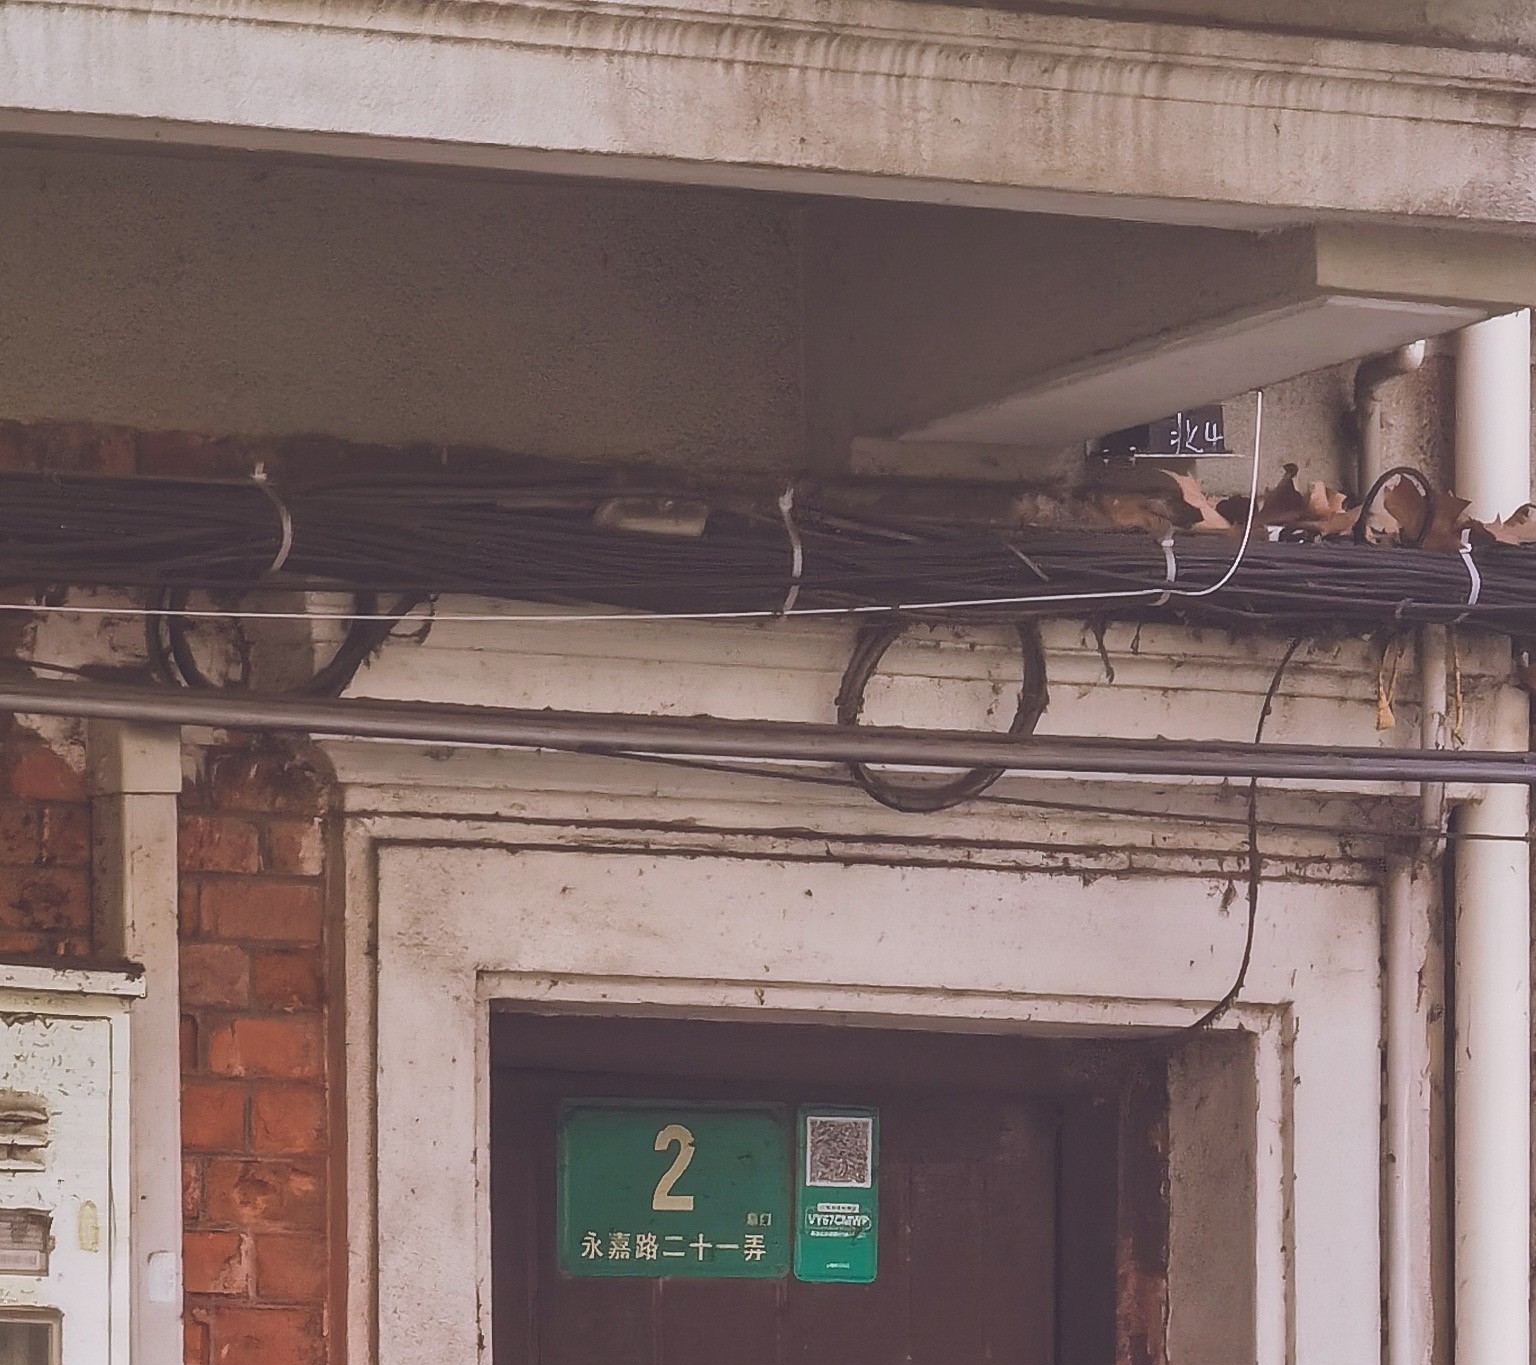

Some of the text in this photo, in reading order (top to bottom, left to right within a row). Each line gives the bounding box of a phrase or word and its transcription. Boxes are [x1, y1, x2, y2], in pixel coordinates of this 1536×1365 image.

[652, 1124, 695, 1211] 2
[581, 1231, 767, 1262] 永嘉路二十一弄
